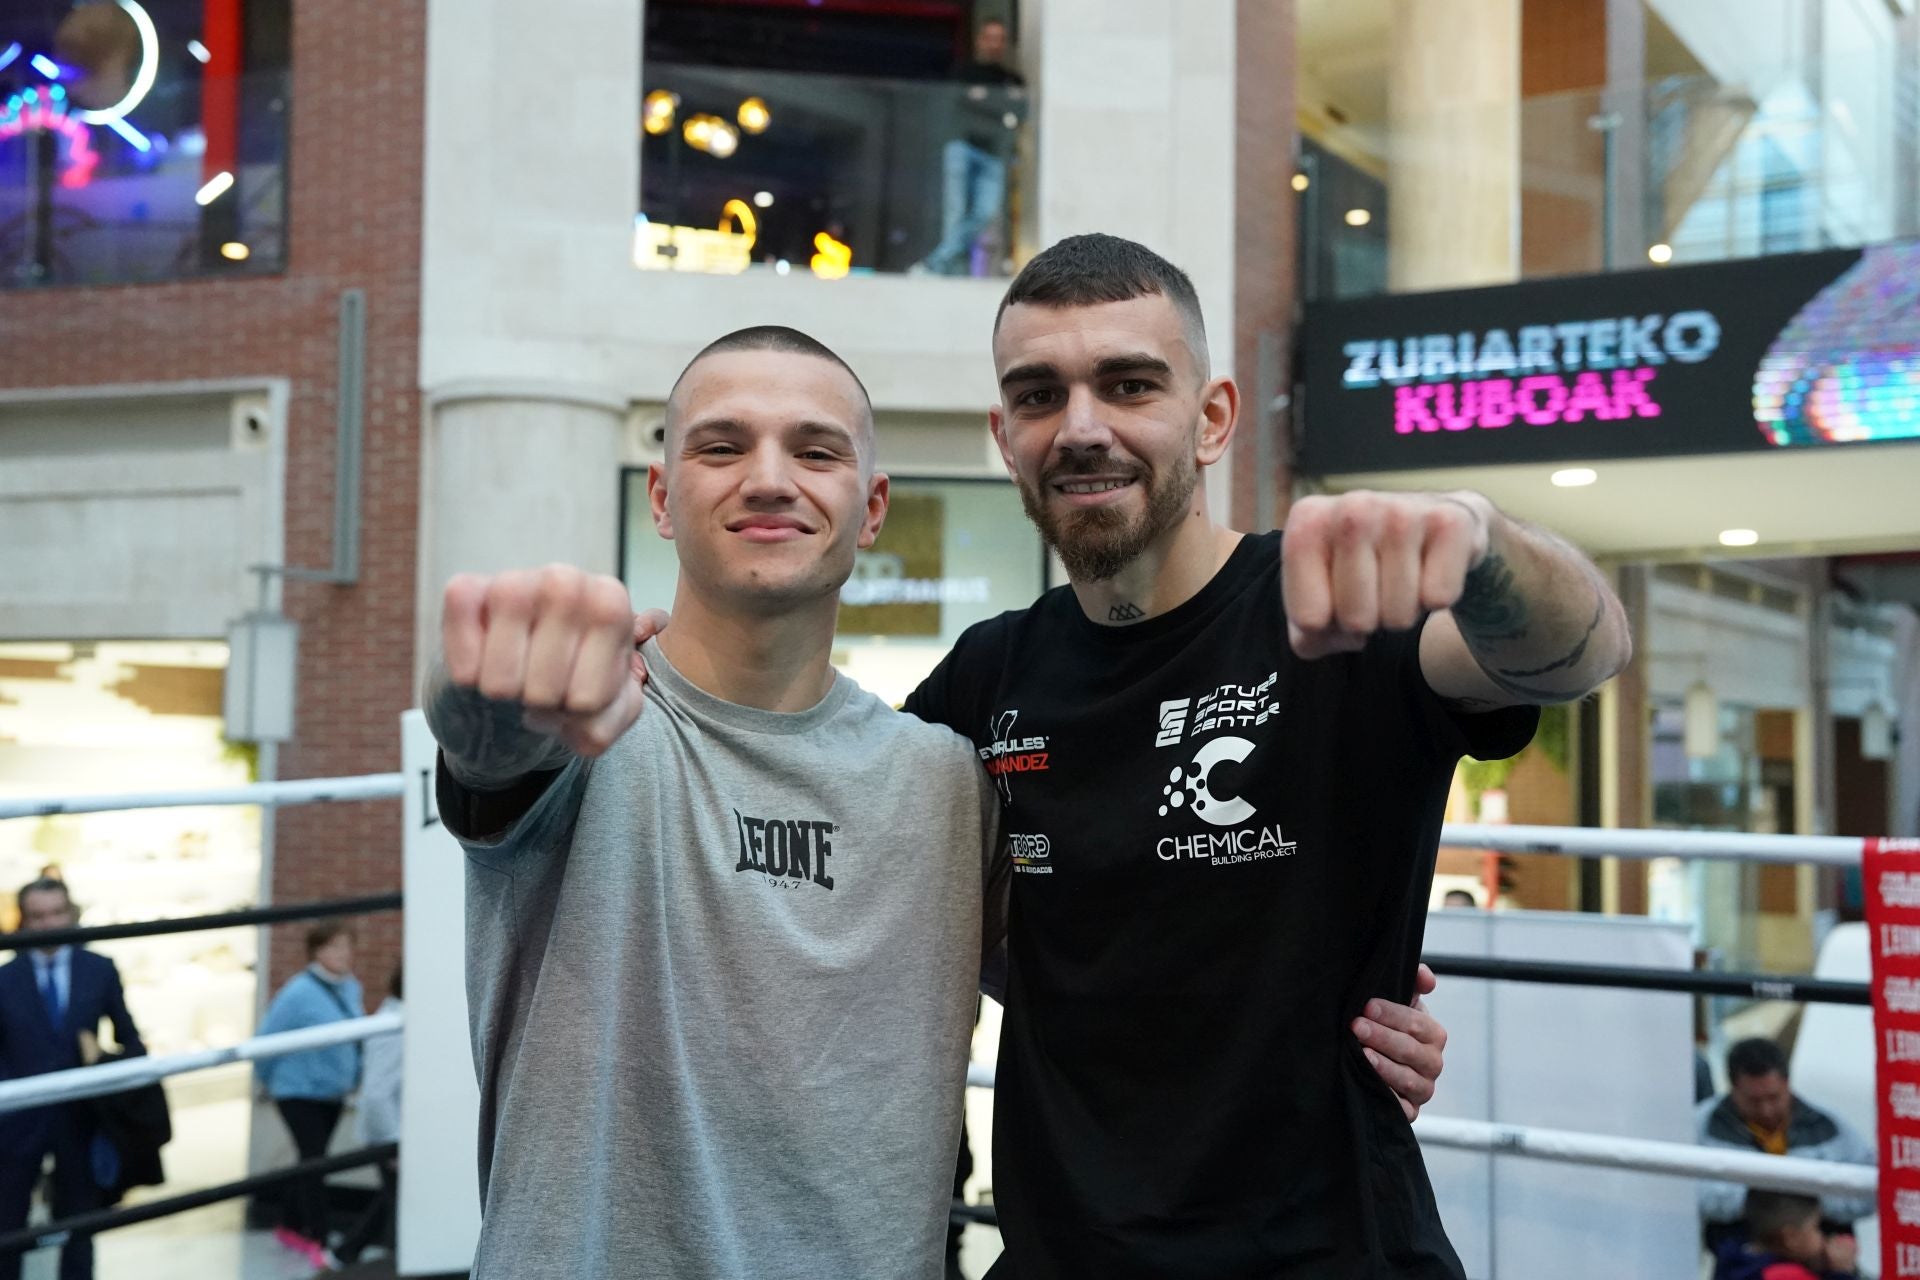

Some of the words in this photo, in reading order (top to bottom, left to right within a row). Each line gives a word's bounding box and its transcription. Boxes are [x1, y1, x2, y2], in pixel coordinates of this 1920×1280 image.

[1342, 309, 1721, 389] ZUBIARTEKO
[1394, 366, 1662, 434] KUBOAK
[1194, 694, 1270, 723] SPORT
[1197, 671, 1278, 708] FUTURE
[733, 808, 835, 891] LEONE
[1156, 823, 1297, 861] CHEMICAL
[1211, 853, 1253, 866] BUILDING
[1253, 845, 1298, 861] PROJECT
